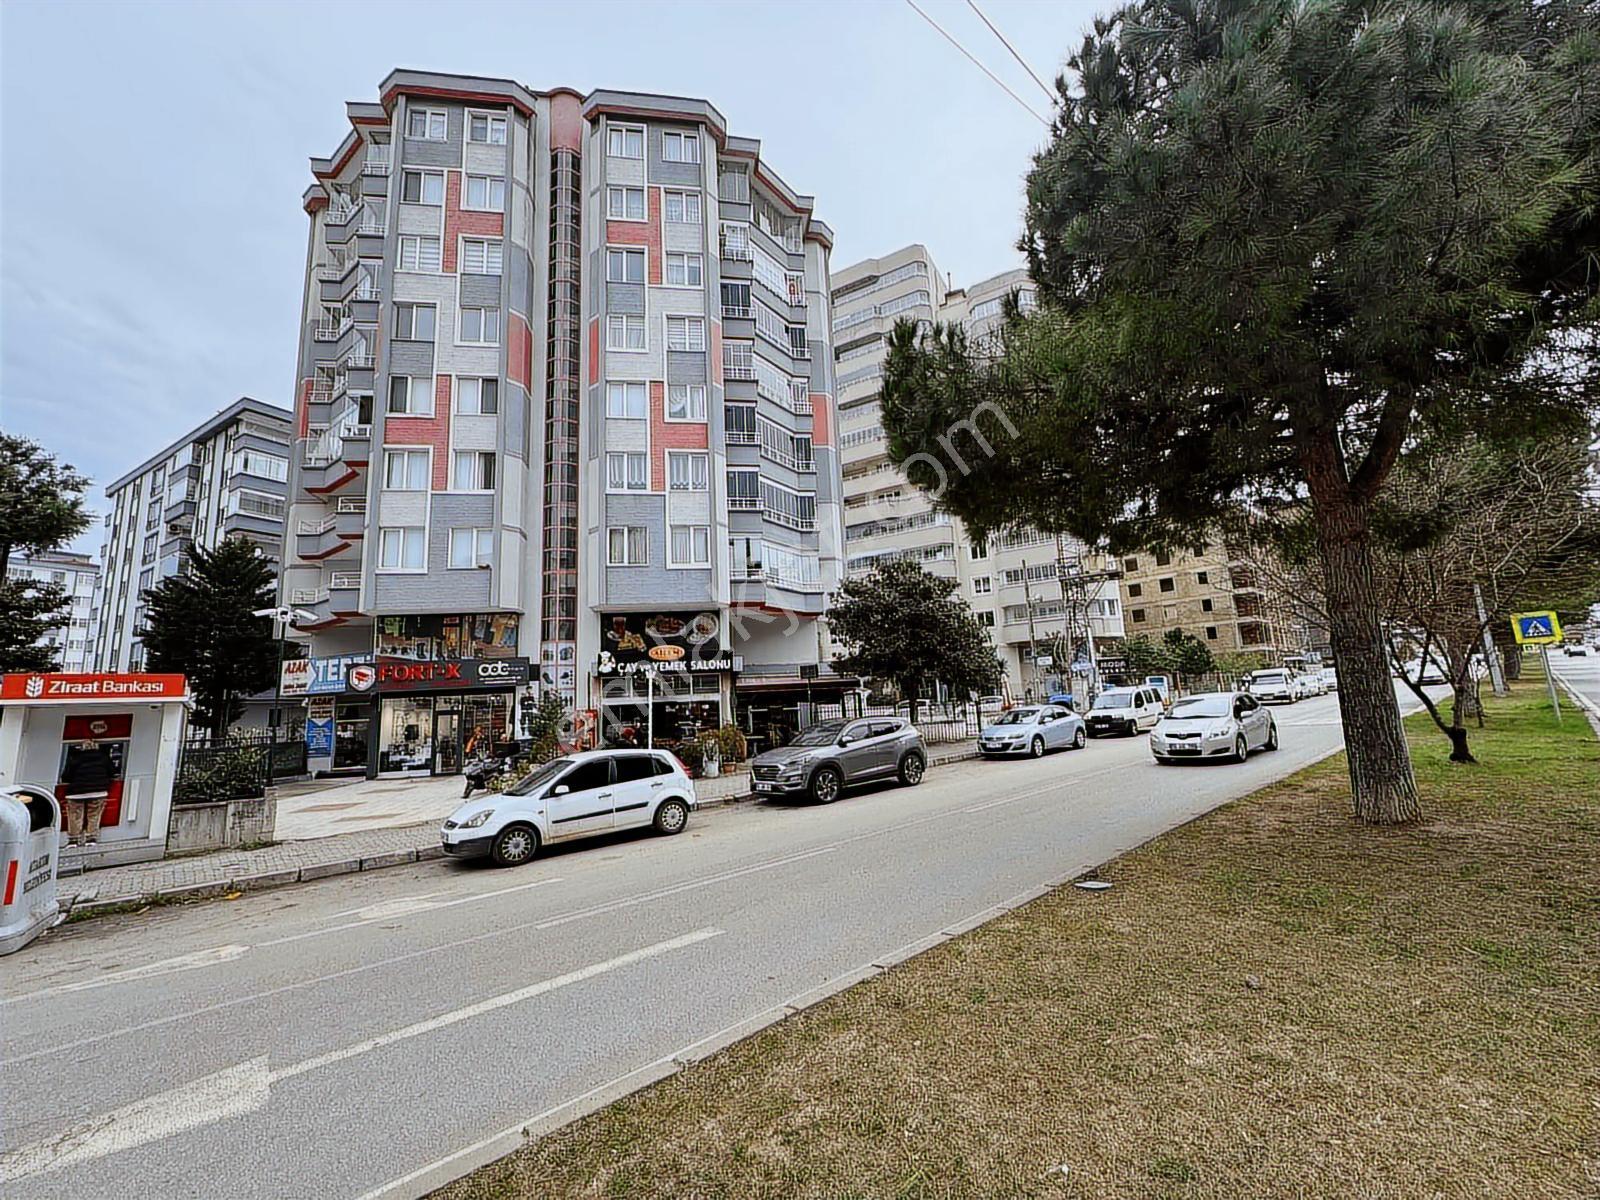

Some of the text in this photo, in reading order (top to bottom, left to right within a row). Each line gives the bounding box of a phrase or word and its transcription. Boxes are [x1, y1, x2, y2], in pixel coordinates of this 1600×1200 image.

[617, 661, 638, 676] ÇAY
[652, 661, 687, 672] YEMEK
[690, 659, 731, 671] SALONU
[48, 680, 163, 693] Ziraat Bankası
